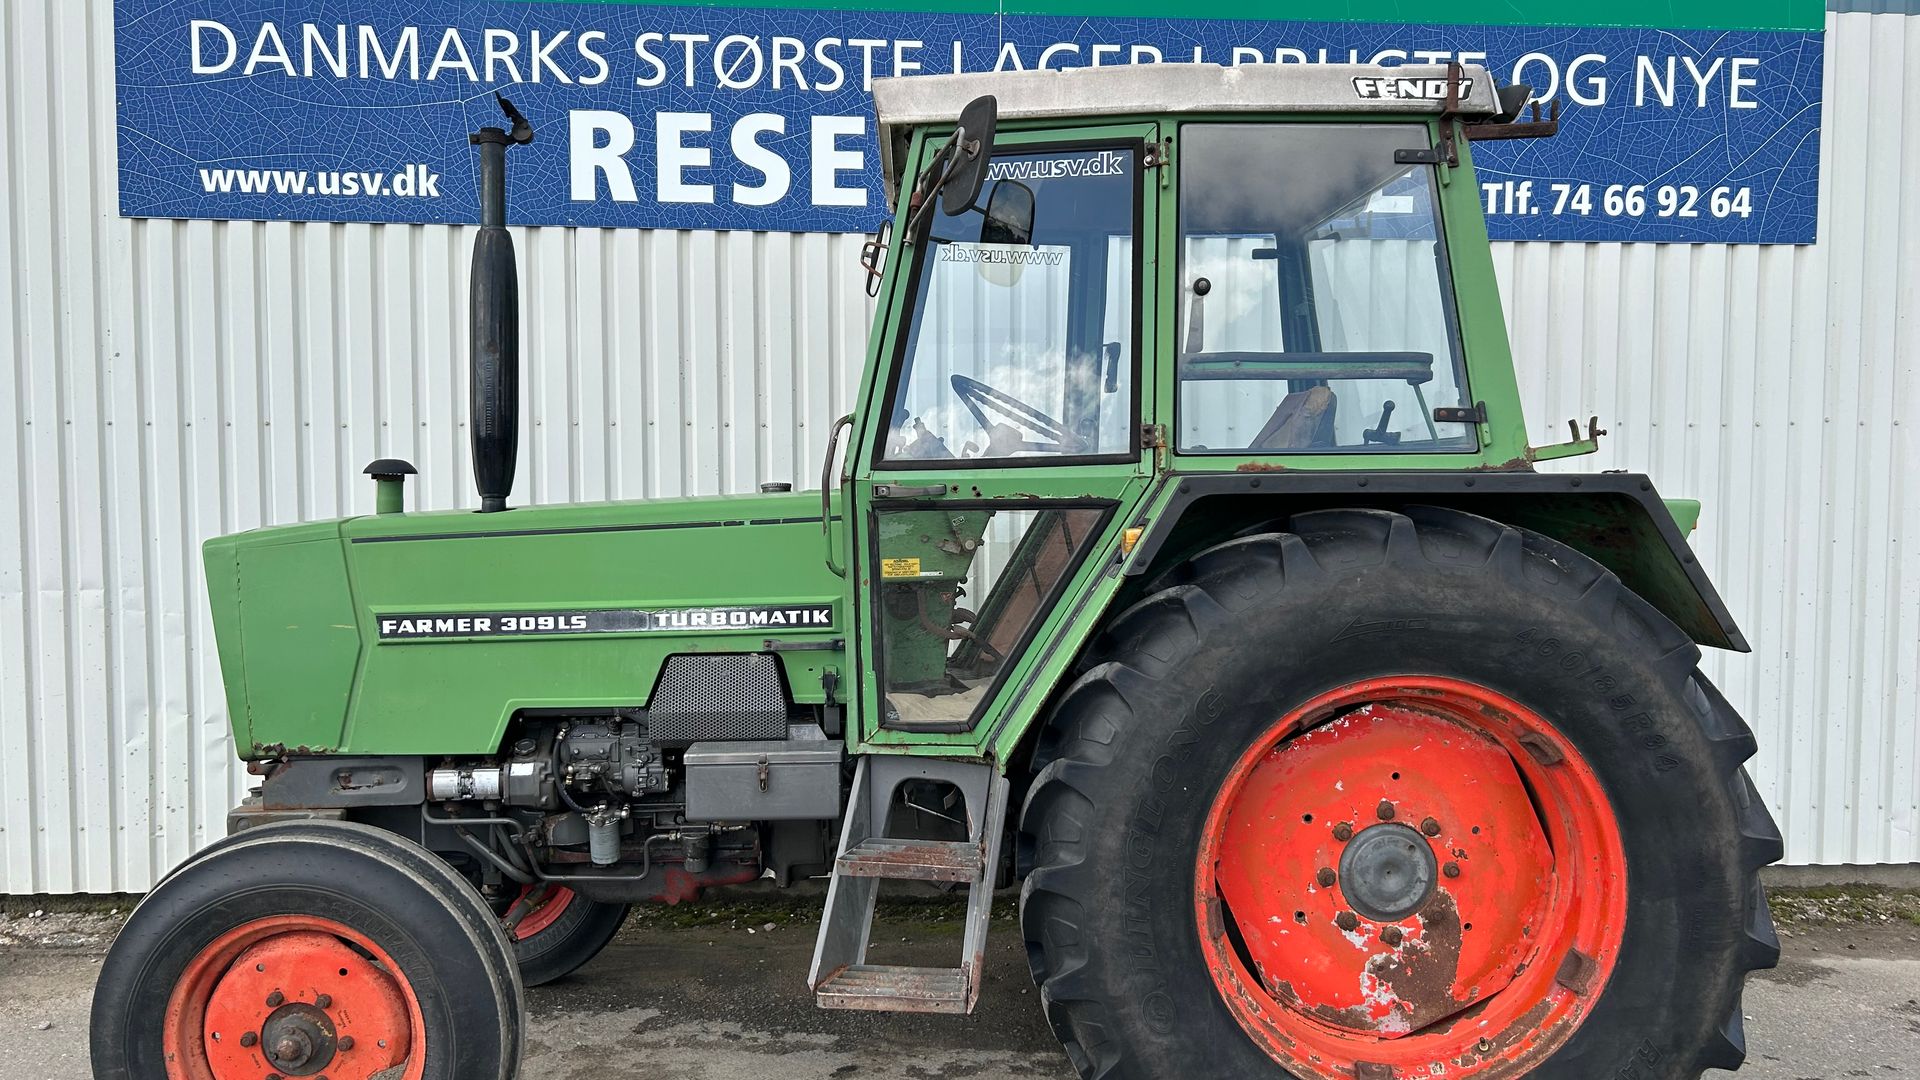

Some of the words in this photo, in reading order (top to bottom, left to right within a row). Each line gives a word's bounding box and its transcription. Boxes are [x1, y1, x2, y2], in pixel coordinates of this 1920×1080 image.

[191, 21, 608, 84] DANMARKS
[636, 33, 923, 93] STØRSTE
[1513, 53, 1606, 106] OG
[1636, 56, 1758, 109] NYE
[199, 164, 440, 197] www.usv.dk
[1483, 181, 1539, 215] Tlf.
[1552, 184, 1591, 215] 74
[1604, 185, 1644, 216] 66
[1658, 186, 1699, 217] 92
[1711, 187, 1752, 218] 64
[382, 618, 491, 634] FARMER
[501, 615, 587, 631] 309LS
[655, 609, 830, 627] TURBOMATIK
